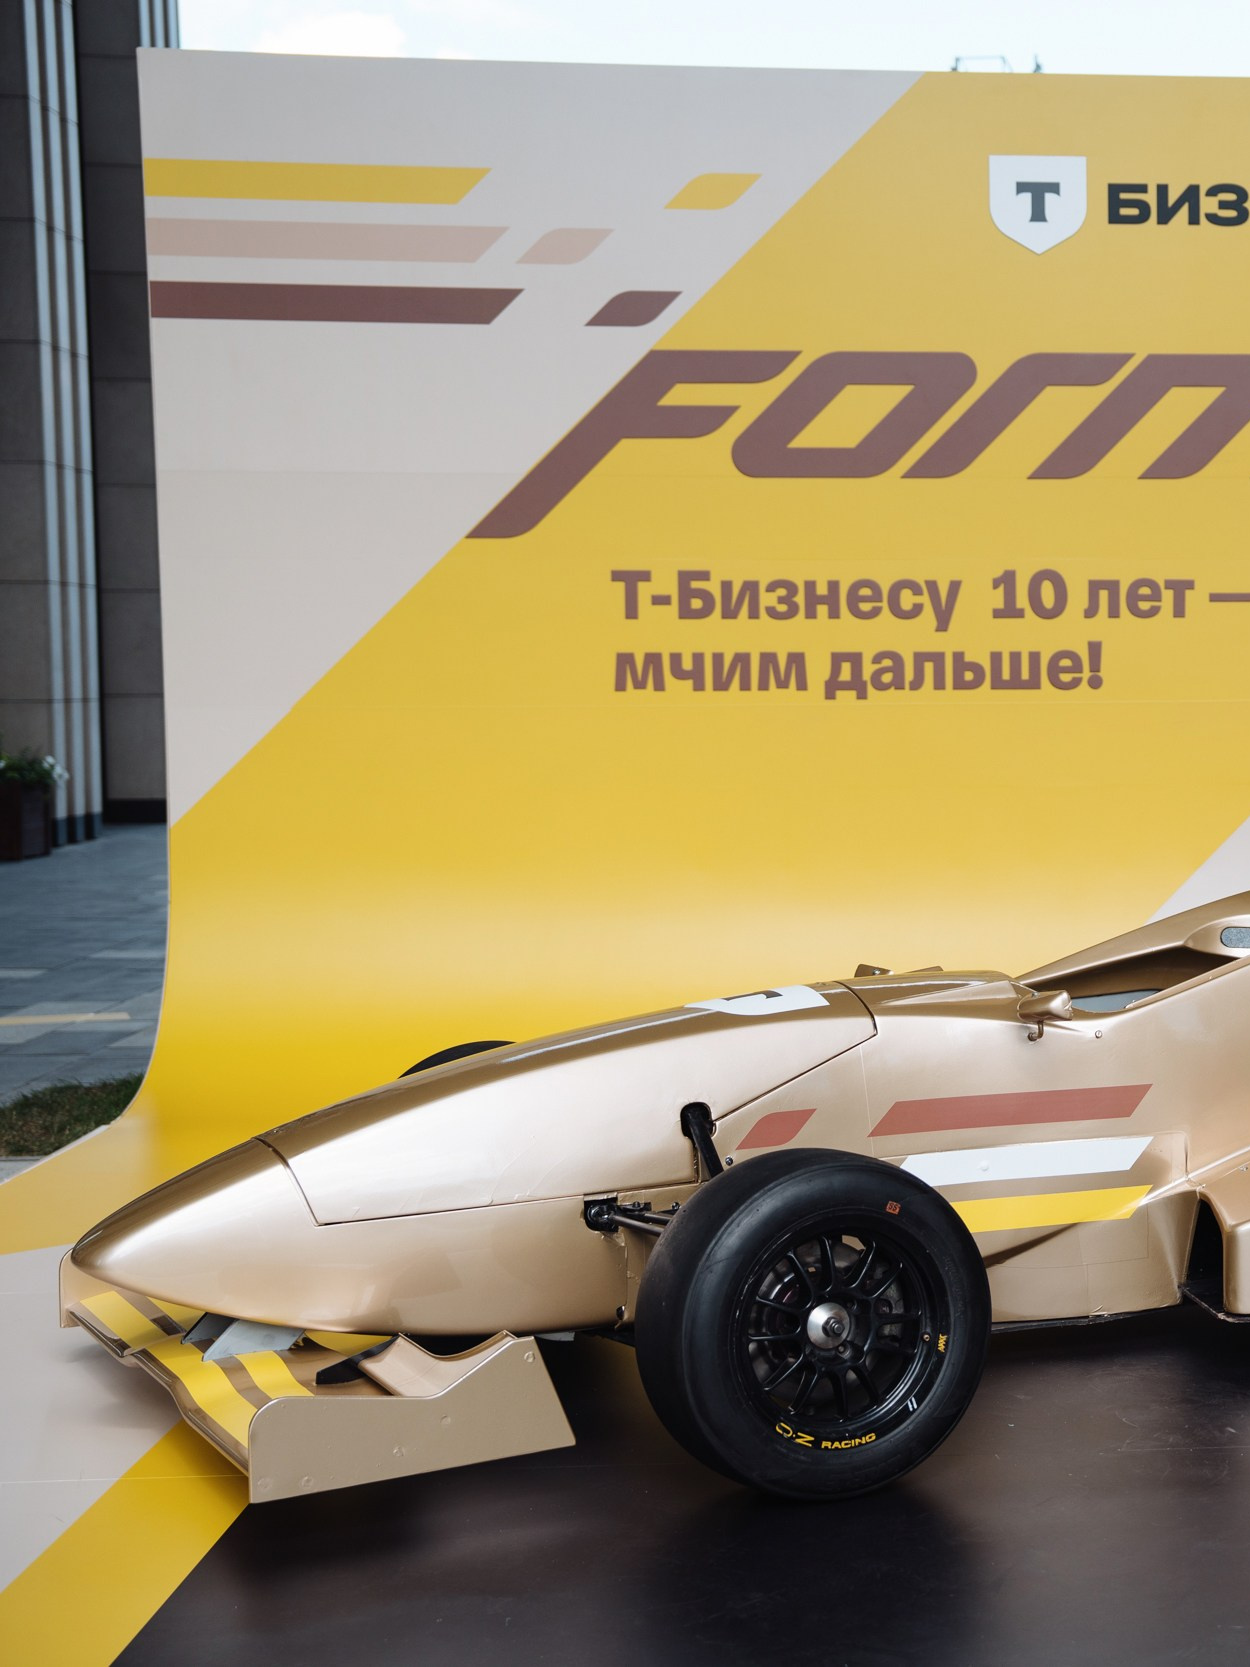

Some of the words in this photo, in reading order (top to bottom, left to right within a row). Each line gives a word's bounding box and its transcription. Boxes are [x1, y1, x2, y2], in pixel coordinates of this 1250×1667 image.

[610, 569, 962, 632] Т-Бизнесу
[991, 568, 1069, 619] 10
[1083, 577, 1195, 619] лет
[613, 652, 809, 692] мчим
[824, 640, 1104, 700] дальше!
[821, 1432, 876, 1449] RACING
